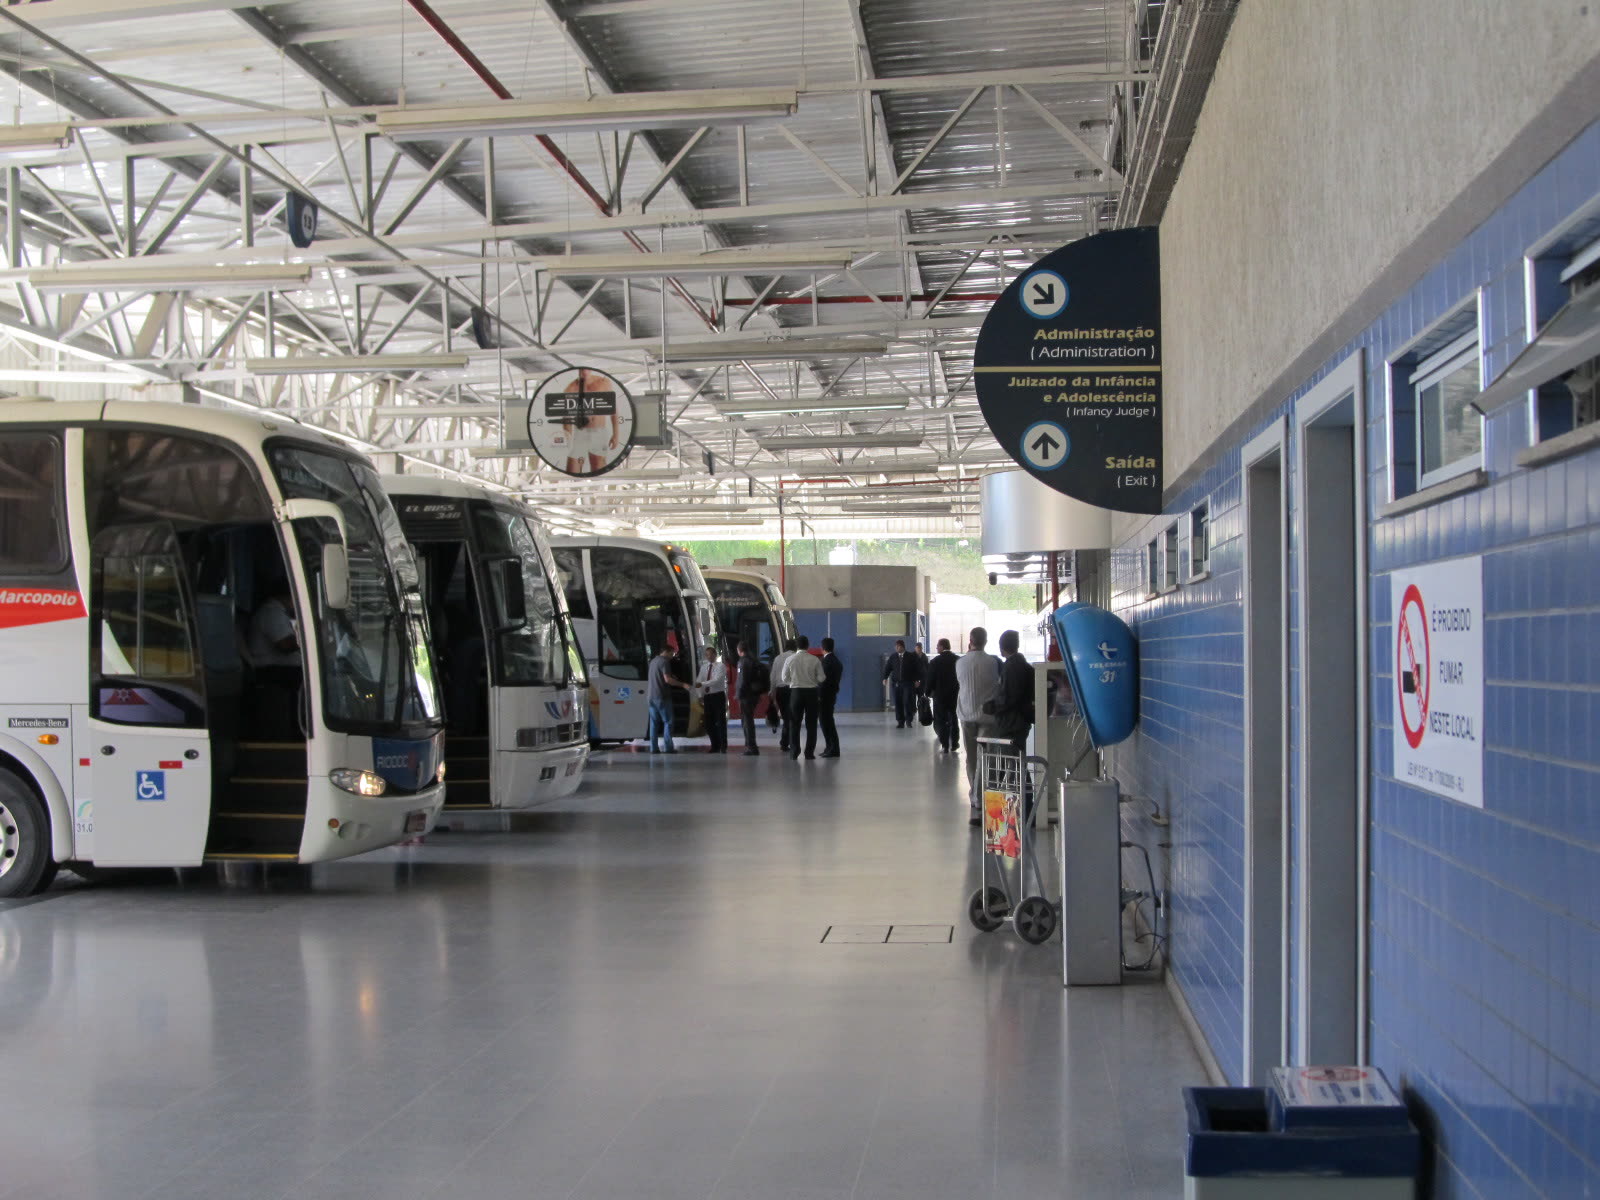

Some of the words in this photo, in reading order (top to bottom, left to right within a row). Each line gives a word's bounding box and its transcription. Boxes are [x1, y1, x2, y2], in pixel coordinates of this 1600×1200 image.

[1033, 326, 1156, 341] Administração
[1007, 376, 1067, 387] Juizado
[1071, 376, 1091, 387] da
[1095, 375, 1156, 387] Infância
[1043, 393, 1053, 403] e
[1056, 392, 1156, 403] Adolescência
[1073, 407, 1113, 418] Infancy
[1115, 407, 1150, 418] Judge
[1105, 454, 1156, 469] Saída
[1125, 475, 1148, 486] Exit
[1438, 607, 1471, 632] PROIBIDO
[1440, 660, 1463, 684] FUMAR
[10, 718, 67, 728] Mercedes-Benz
[1429, 711, 1450, 736] NESTE
[1451, 714, 1475, 741] LOCAL
